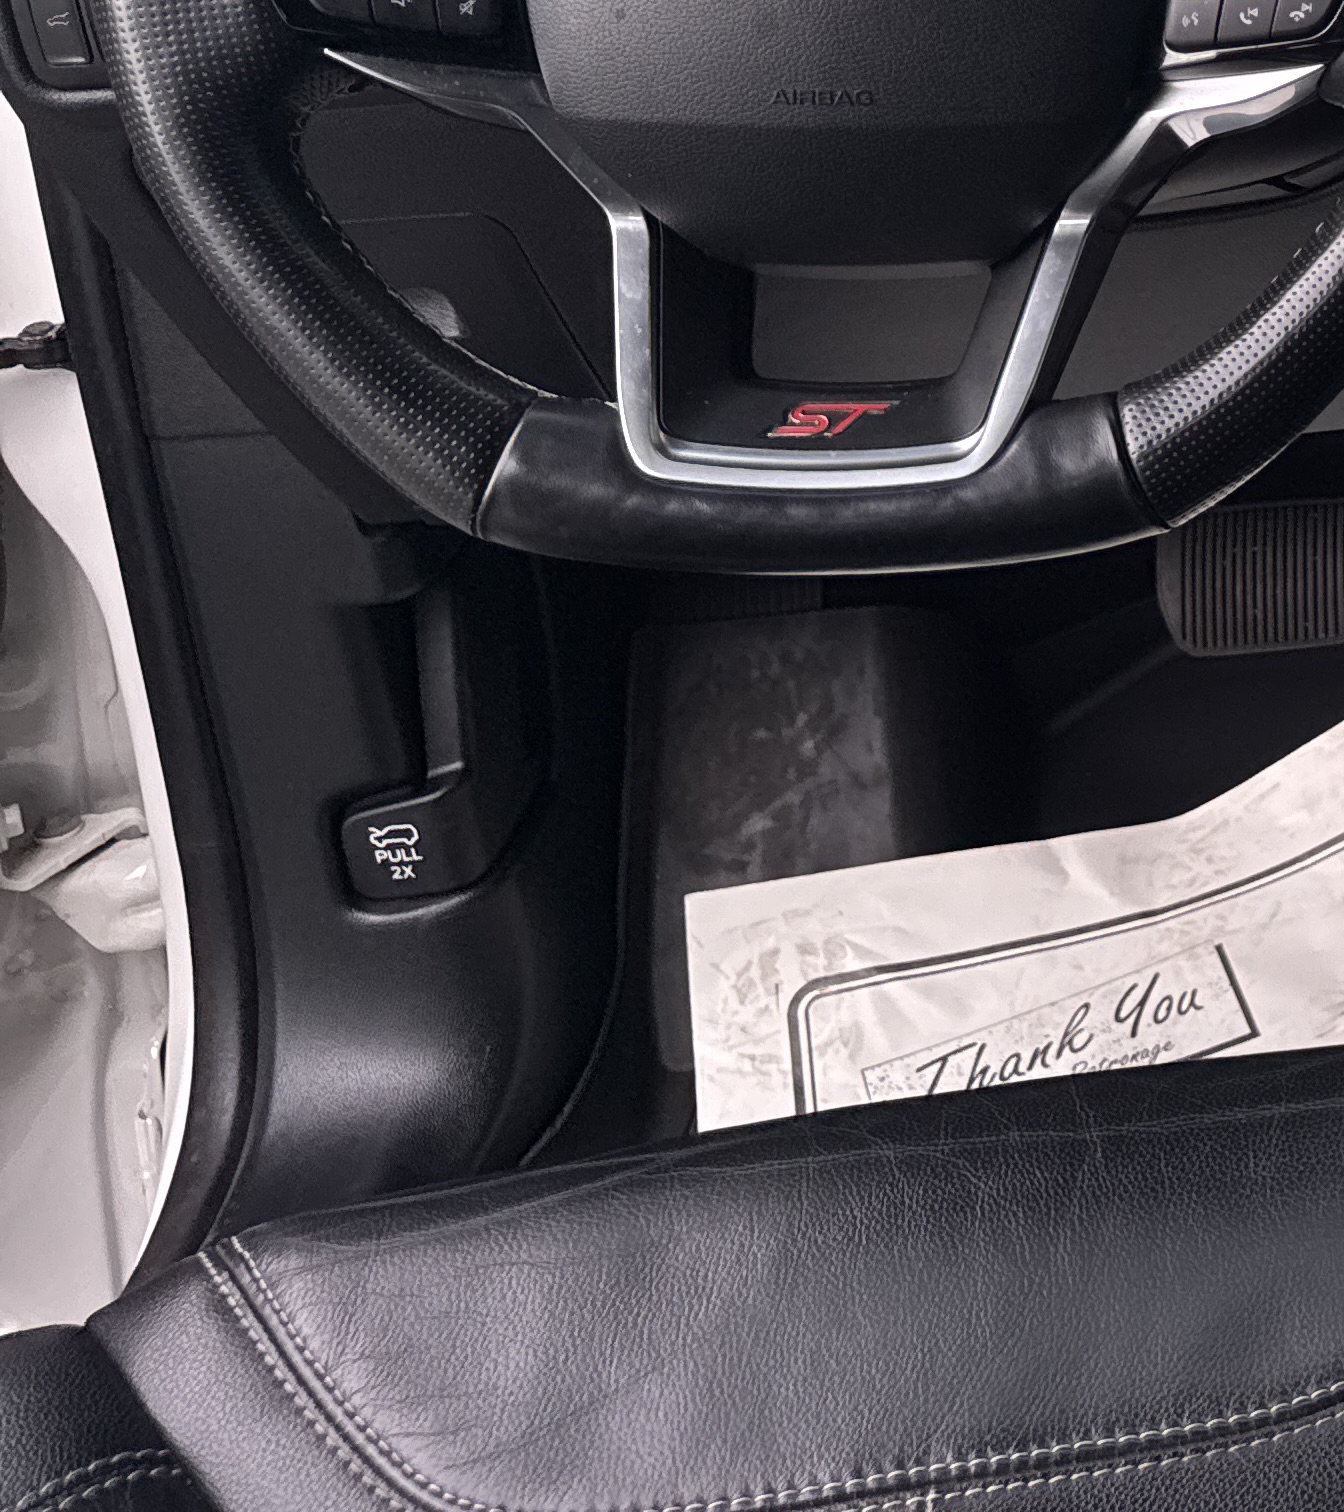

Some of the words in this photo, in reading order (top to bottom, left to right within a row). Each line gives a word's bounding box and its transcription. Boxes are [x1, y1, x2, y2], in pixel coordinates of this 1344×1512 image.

[770, 88, 875, 106] AIRBAG
[767, 400, 901, 438] ST
[374, 847, 424, 864] PULL
[390, 864, 416, 881] 2X
[916, 1001, 1096, 1096] Thank
[1114, 972, 1204, 1039] You
